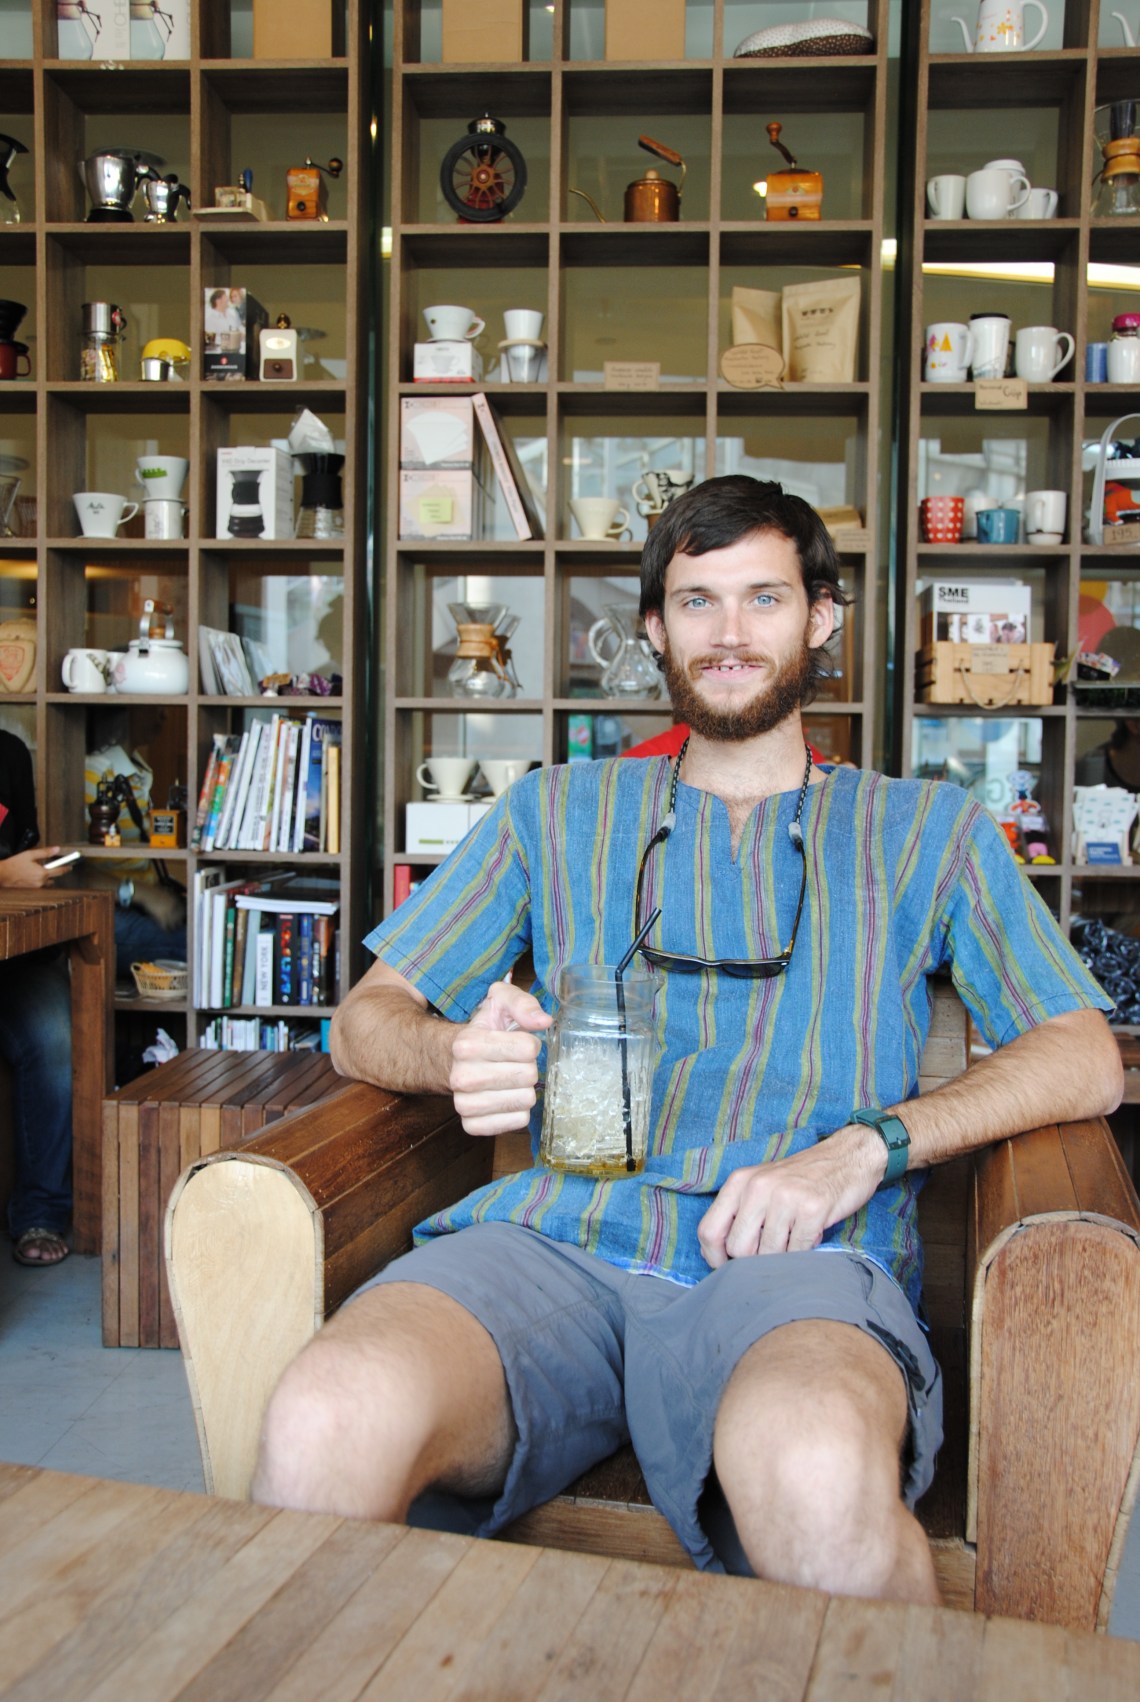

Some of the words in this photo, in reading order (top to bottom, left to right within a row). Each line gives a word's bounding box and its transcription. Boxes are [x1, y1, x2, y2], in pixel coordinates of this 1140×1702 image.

[939, 586, 969, 598] SME
[260, 946, 269, 969] YORK
[260, 971, 269, 991] NEW
